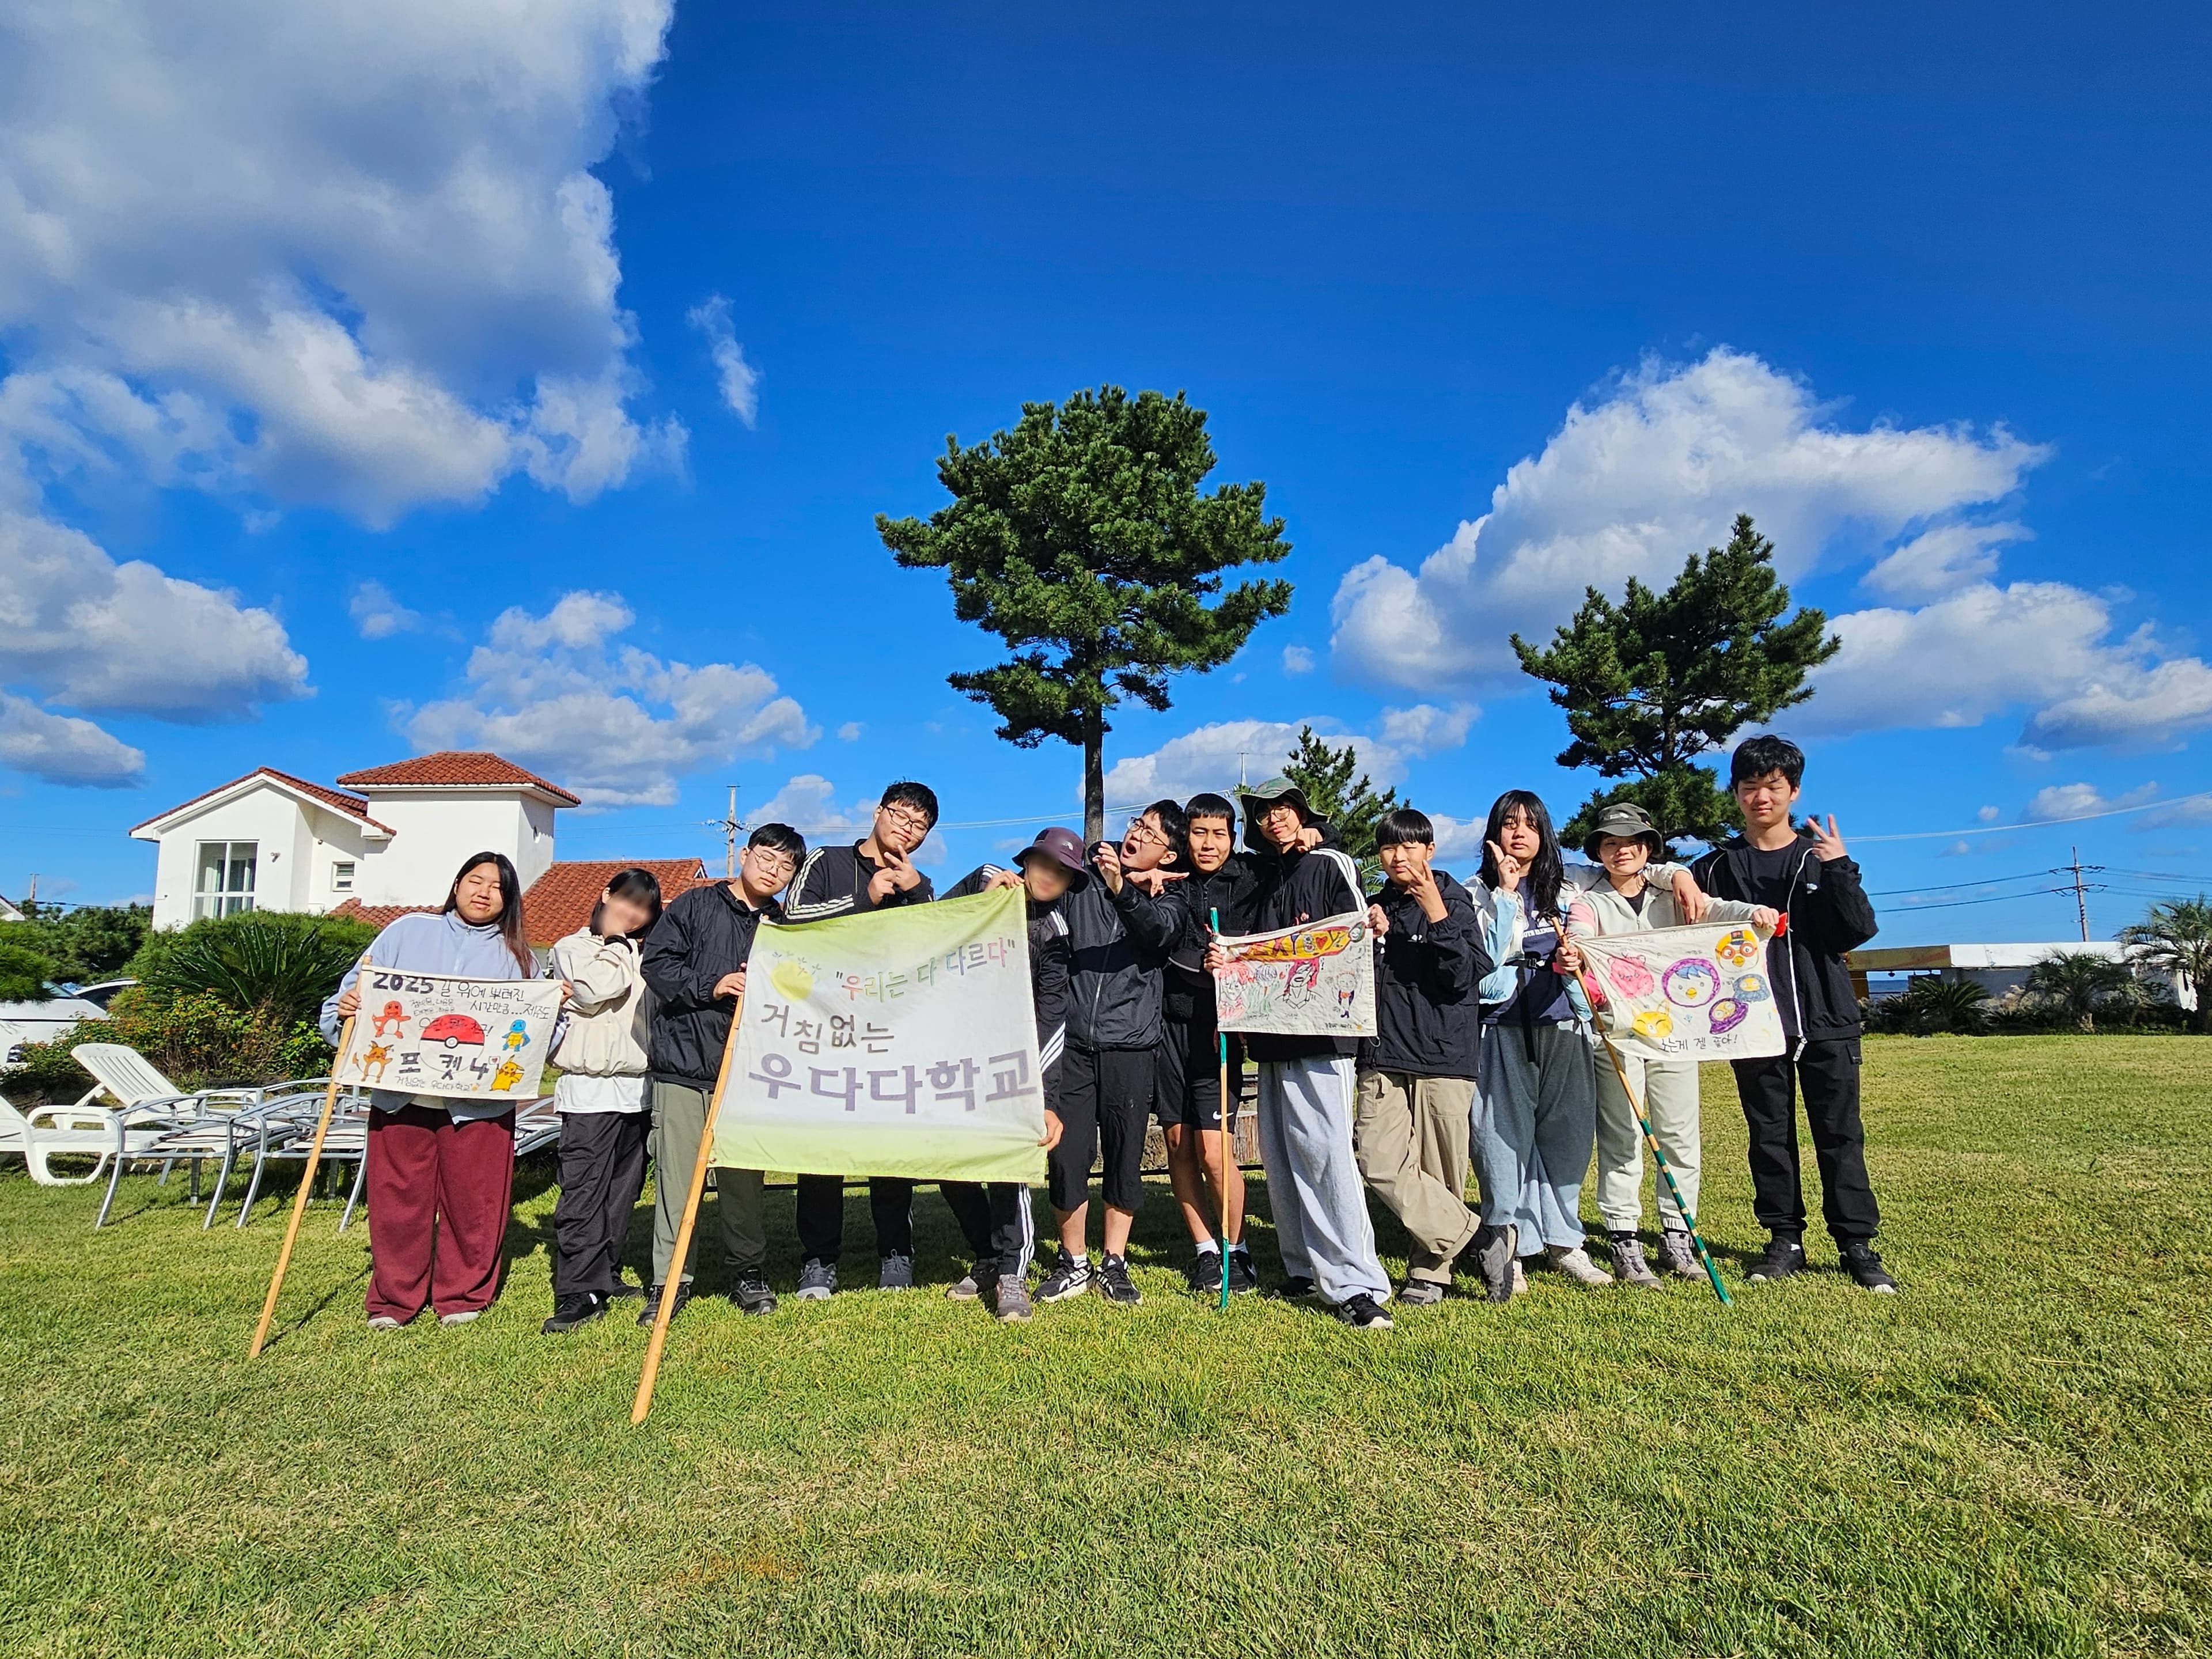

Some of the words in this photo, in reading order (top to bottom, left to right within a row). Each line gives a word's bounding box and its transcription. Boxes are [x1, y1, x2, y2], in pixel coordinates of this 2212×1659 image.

[916, 957, 937, 986] 다
[372, 972, 434, 994] 2025
[440, 979, 452, 997] 길
[457, 981, 486, 998] 위에
[489, 987, 524, 1002] 뿌려진
[760, 1003, 895, 1055] 거침없는
[1693, 1036, 1706, 1050] 젤
[749, 1048, 1038, 1114] 우다다학교
